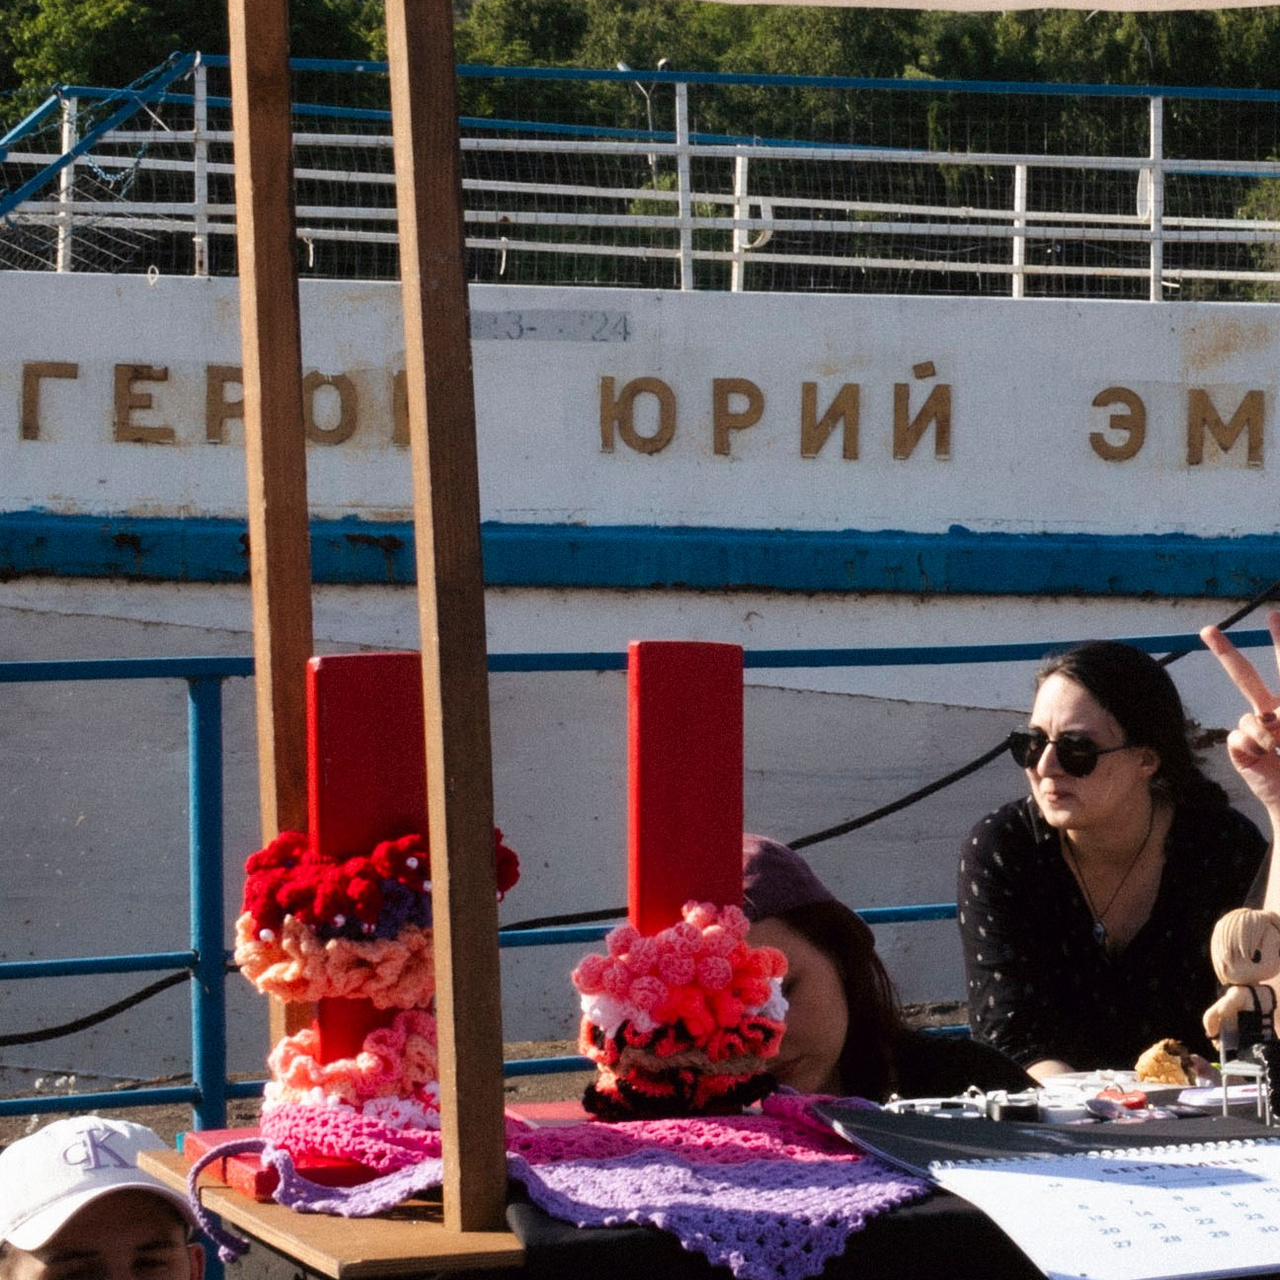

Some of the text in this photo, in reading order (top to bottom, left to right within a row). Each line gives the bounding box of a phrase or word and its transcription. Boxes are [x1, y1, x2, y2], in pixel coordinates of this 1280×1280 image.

[22, 360, 1265, 469] ГЕРО ЮРИЙ ЭМ
